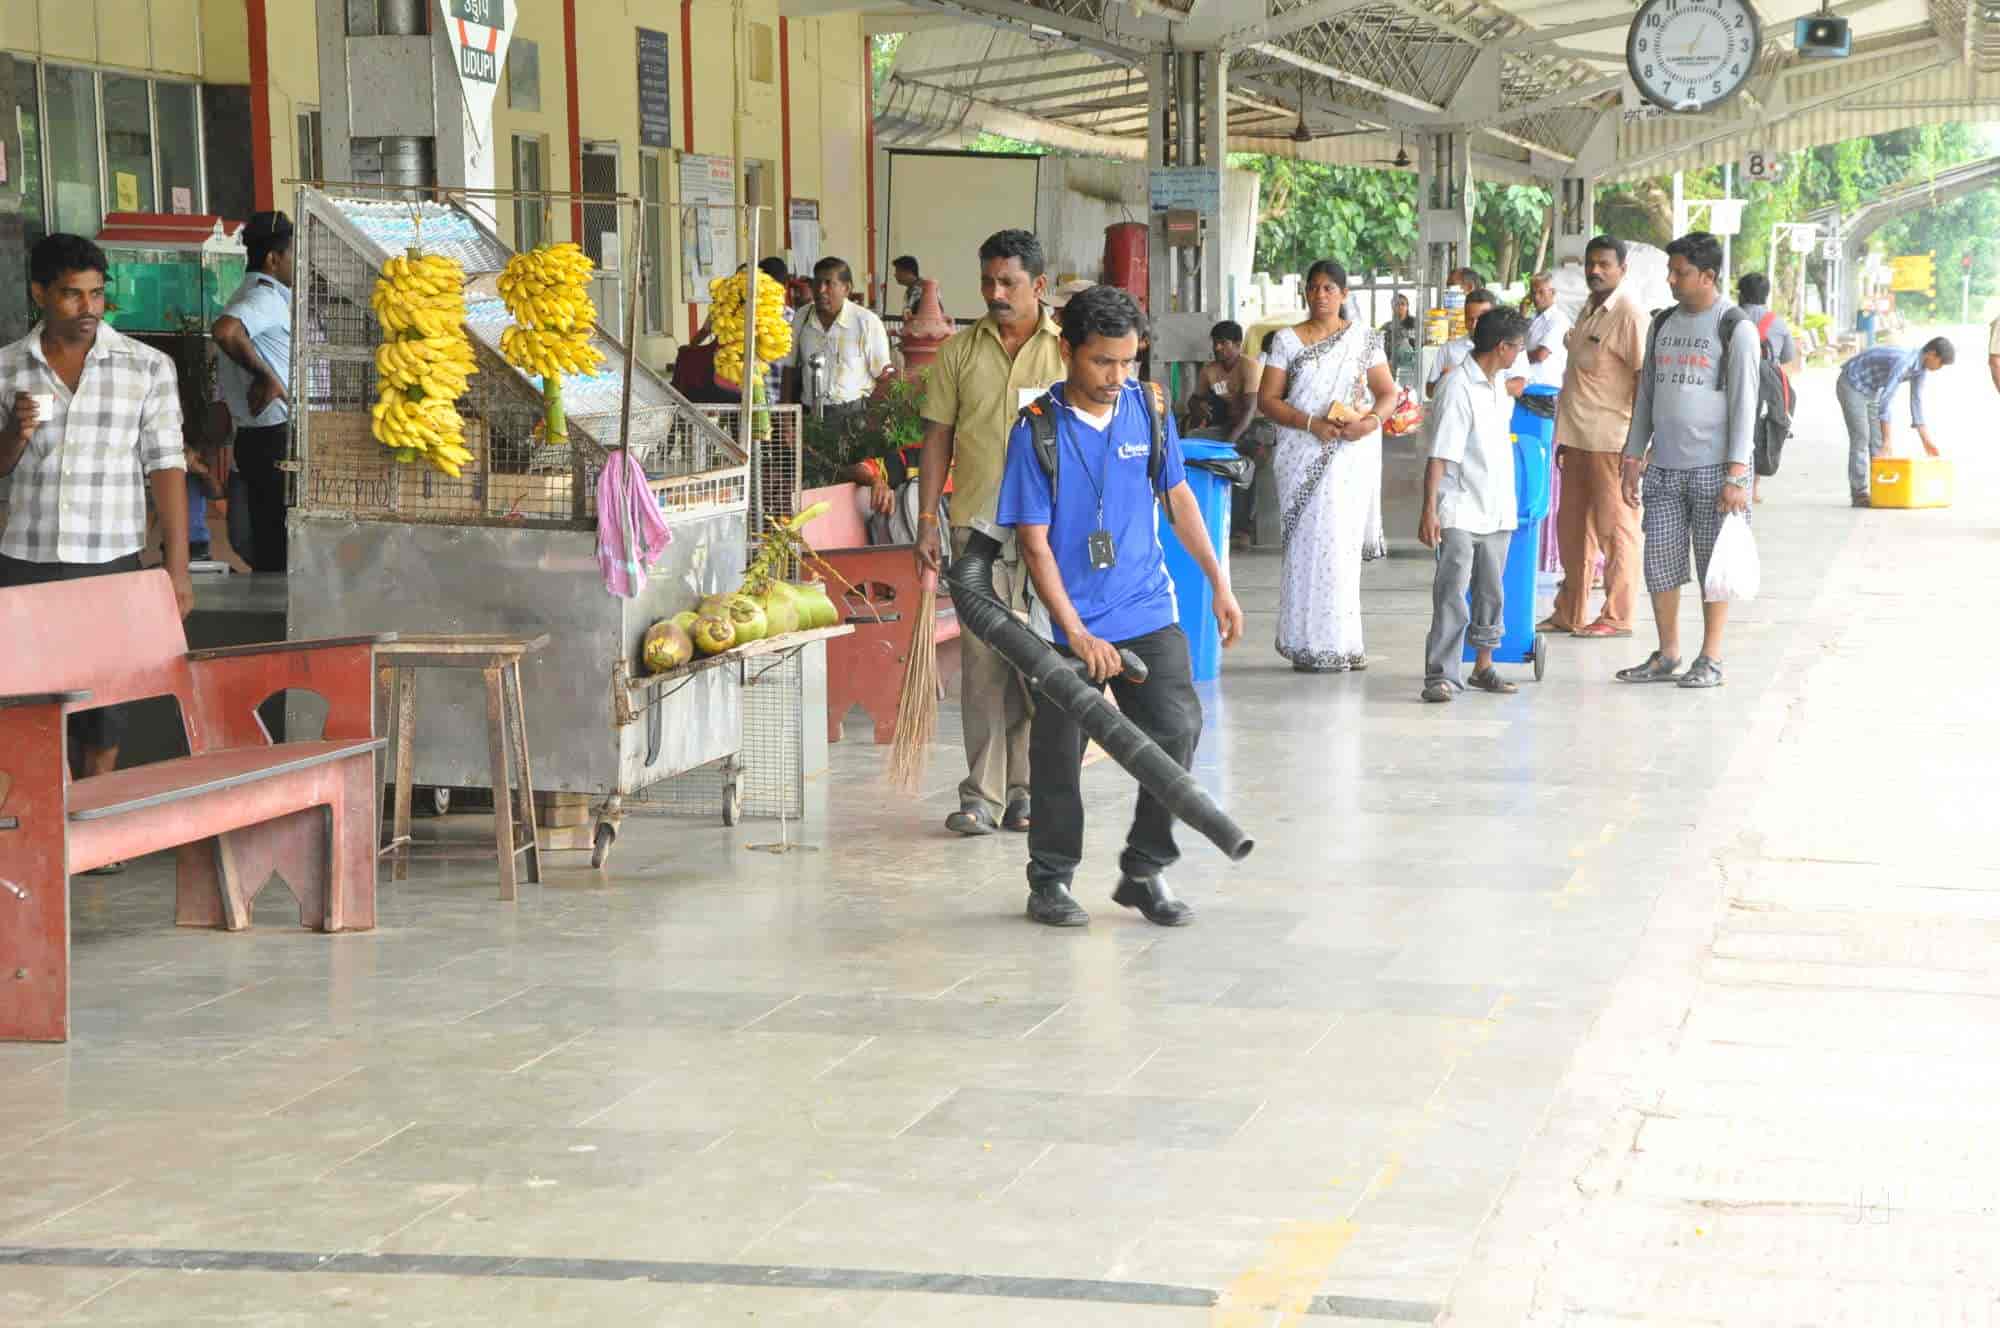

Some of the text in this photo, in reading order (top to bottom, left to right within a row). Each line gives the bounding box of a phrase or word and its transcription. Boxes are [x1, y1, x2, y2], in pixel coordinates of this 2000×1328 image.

[1645, 14, 1660, 28] 10
[1734, 14, 1744, 28] 2
[1638, 38, 1647, 52] 9
[1741, 38, 1749, 52] 3
[463, 49, 494, 79] UDUPI
[1730, 64, 1739, 77] 4
[1644, 64, 1653, 79] 8
[1663, 81, 1671, 95] 7
[1687, 87, 1696, 99] 6
[1712, 80, 1721, 94] 5
[1750, 155, 1765, 176] 8
